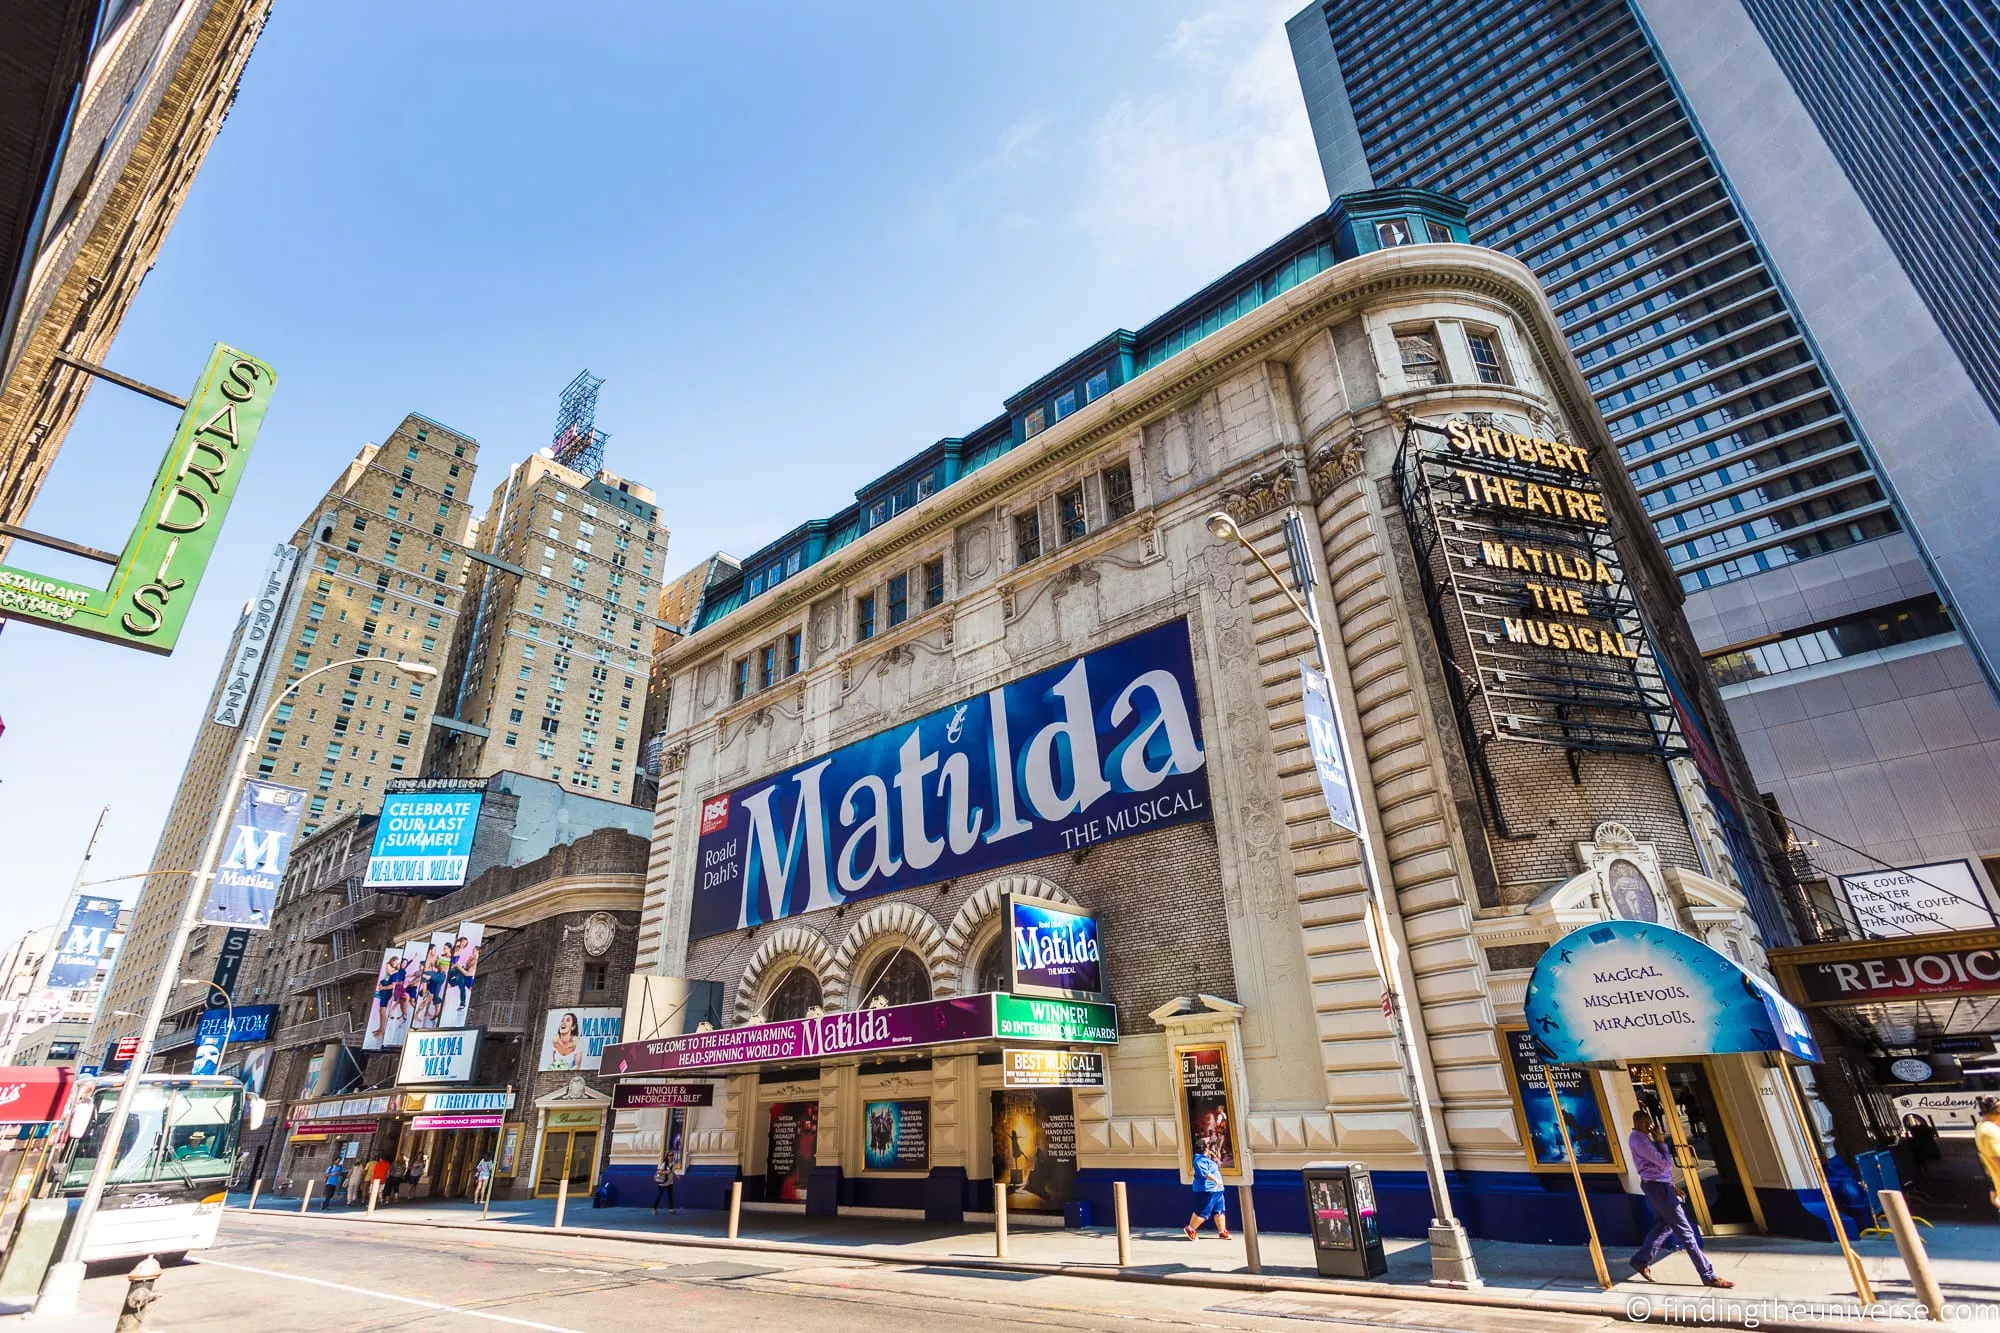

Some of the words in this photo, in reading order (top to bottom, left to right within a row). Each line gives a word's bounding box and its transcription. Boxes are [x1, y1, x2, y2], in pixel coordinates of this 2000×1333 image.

[1447, 420, 1591, 474] SHUBERT
[122, 359, 261, 635] SARDI'S
[1455, 470, 1608, 525] THEATRE
[1480, 541, 1614, 585] MATILDA
[249, 543, 297, 641] MILFORD
[1527, 583, 1589, 616] THE
[1503, 616, 1639, 659] MUSICAL
[216, 646, 259, 725] PLAZA
[736, 657, 1206, 930] Matilda
[389, 802, 471, 816] CELEBRATE
[704, 798, 728, 822] RSC
[1060, 820, 1102, 850] THE
[1106, 788, 1203, 834] MUSICAL
[388, 818, 422, 832] OUR
[428, 818, 465, 830] LAST
[219, 824, 287, 875] M
[386, 832, 460, 846] SUMMER!
[705, 838, 737, 868] Roald
[218, 870, 275, 890] Matilda
[367, 860, 425, 881] MAMMA
[426, 859, 463, 881] MIA!
[703, 861, 738, 890] Dahl's
[1846, 881, 1869, 891] WE
[1873, 876, 1915, 888] COVER
[1851, 889, 1910, 903] THEATER
[1858, 905, 1886, 915] LIKE
[1888, 901, 1911, 912] WE
[1916, 896, 1960, 909] COVER
[1862, 918, 1889, 928] THE
[1891, 912, 1944, 925] WORLD.
[61, 925, 107, 957] M
[1014, 923, 1099, 971] Matilda
[211, 927, 248, 1006] STIC
[1593, 965, 1663, 983] MAGICAL.
[1818, 951, 2000, 991] “REJOIC
[1583, 986, 1690, 1007] MISCHIEVOUS.
[199, 1014, 270, 1036] PHANTOM
[1029, 1002, 1088, 1025] WINNER!
[688, 1038, 699, 1050] TO
[700, 1035, 717, 1049] THE
[718, 1026, 797, 1046] HEARTWARMING,
[801, 1010, 891, 1057] Matilda
[1001, 1020, 1012, 1033] 50
[1013, 1021, 1083, 1038] INTERNATIONAL
[1083, 1027, 1116, 1040] AWARDS
[416, 1036, 463, 1057] MAMMA
[678, 1047, 744, 1066] HEAD-SPINNING
[746, 1043, 780, 1058] WORLD
[781, 1042, 795, 1055] OF
[422, 1056, 452, 1077] MIA!
[1014, 1053, 1042, 1070] BEST
[1044, 1054, 1095, 1071] MUSICAL!
[1520, 1073, 1544, 1081] YOUR
[1549, 1072, 1572, 1080] AITH
[679, 1085, 687, 1094] &
[1760, 1087, 1774, 1096] 225
[1918, 1096, 1977, 1110] Academy
